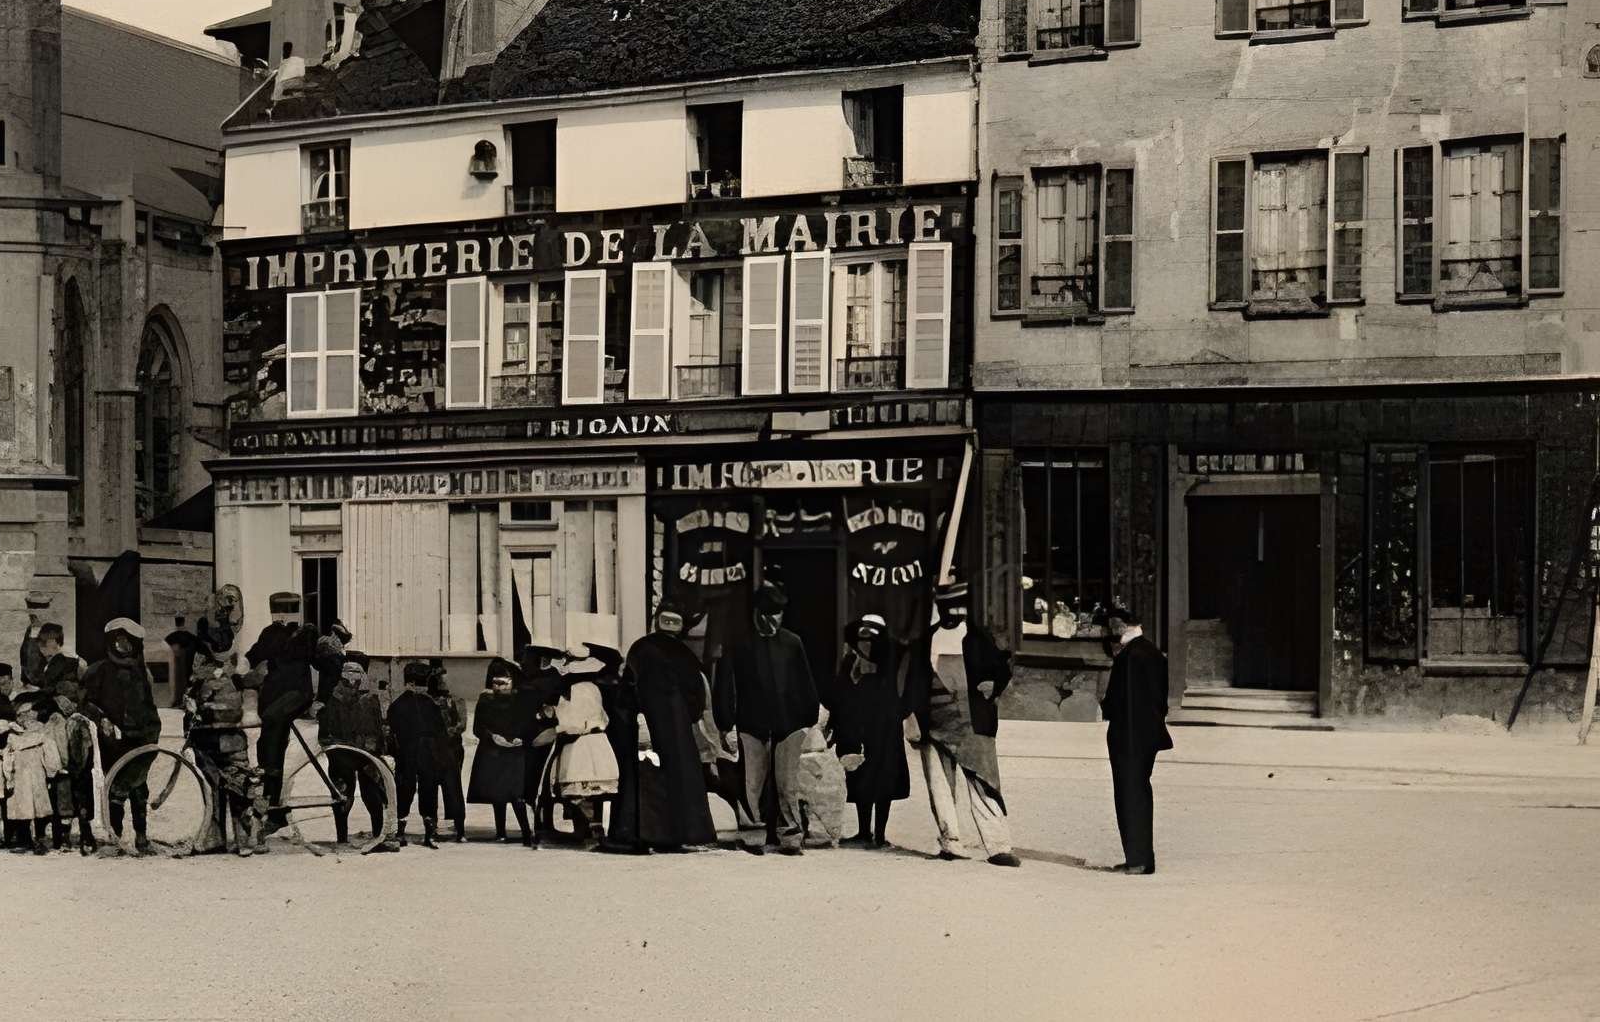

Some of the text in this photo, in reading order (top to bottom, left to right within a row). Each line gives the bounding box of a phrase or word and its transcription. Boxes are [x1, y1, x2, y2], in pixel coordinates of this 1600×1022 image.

[245, 204, 943, 291] IMPRIMERIE DE LA MAIRIE
